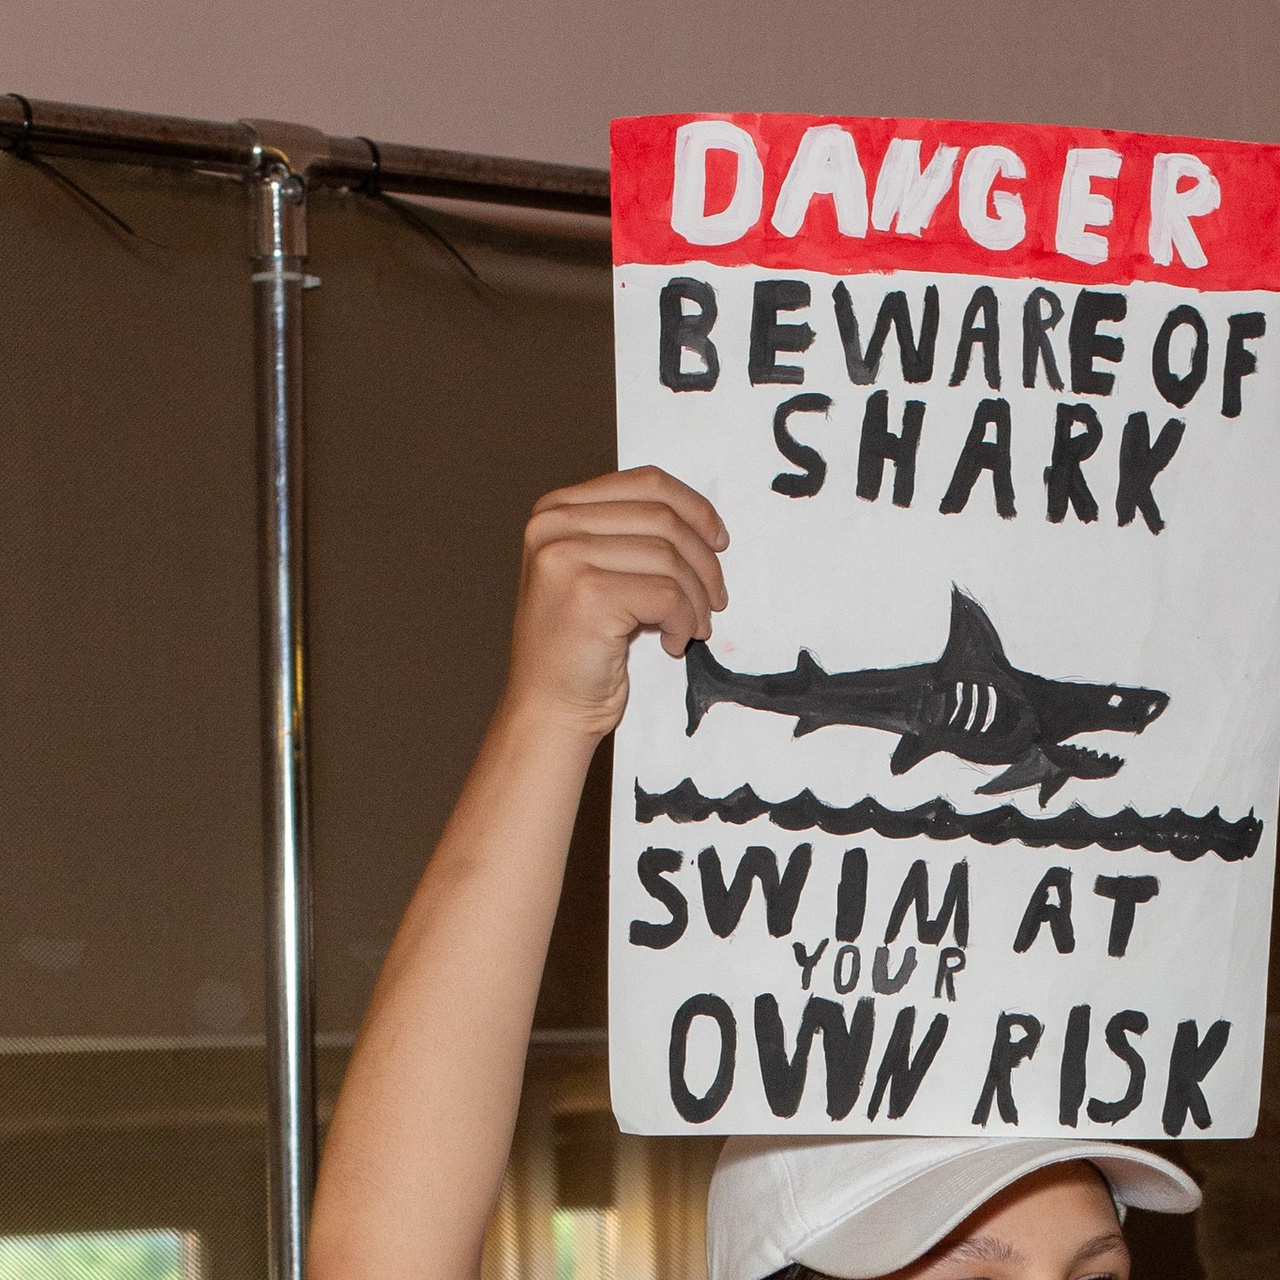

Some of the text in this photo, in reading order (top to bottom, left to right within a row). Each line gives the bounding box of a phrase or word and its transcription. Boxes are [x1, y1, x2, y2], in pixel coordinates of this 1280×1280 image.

[671, 120, 1221, 269] DANGER
[658, 276, 1267, 418] BEWARE OF
[770, 389, 1187, 536] SHARK
[629, 842, 1160, 957] SWIM AT
[791, 937, 967, 1002] YOUR
[669, 992, 1232, 1137] OWN RISK
